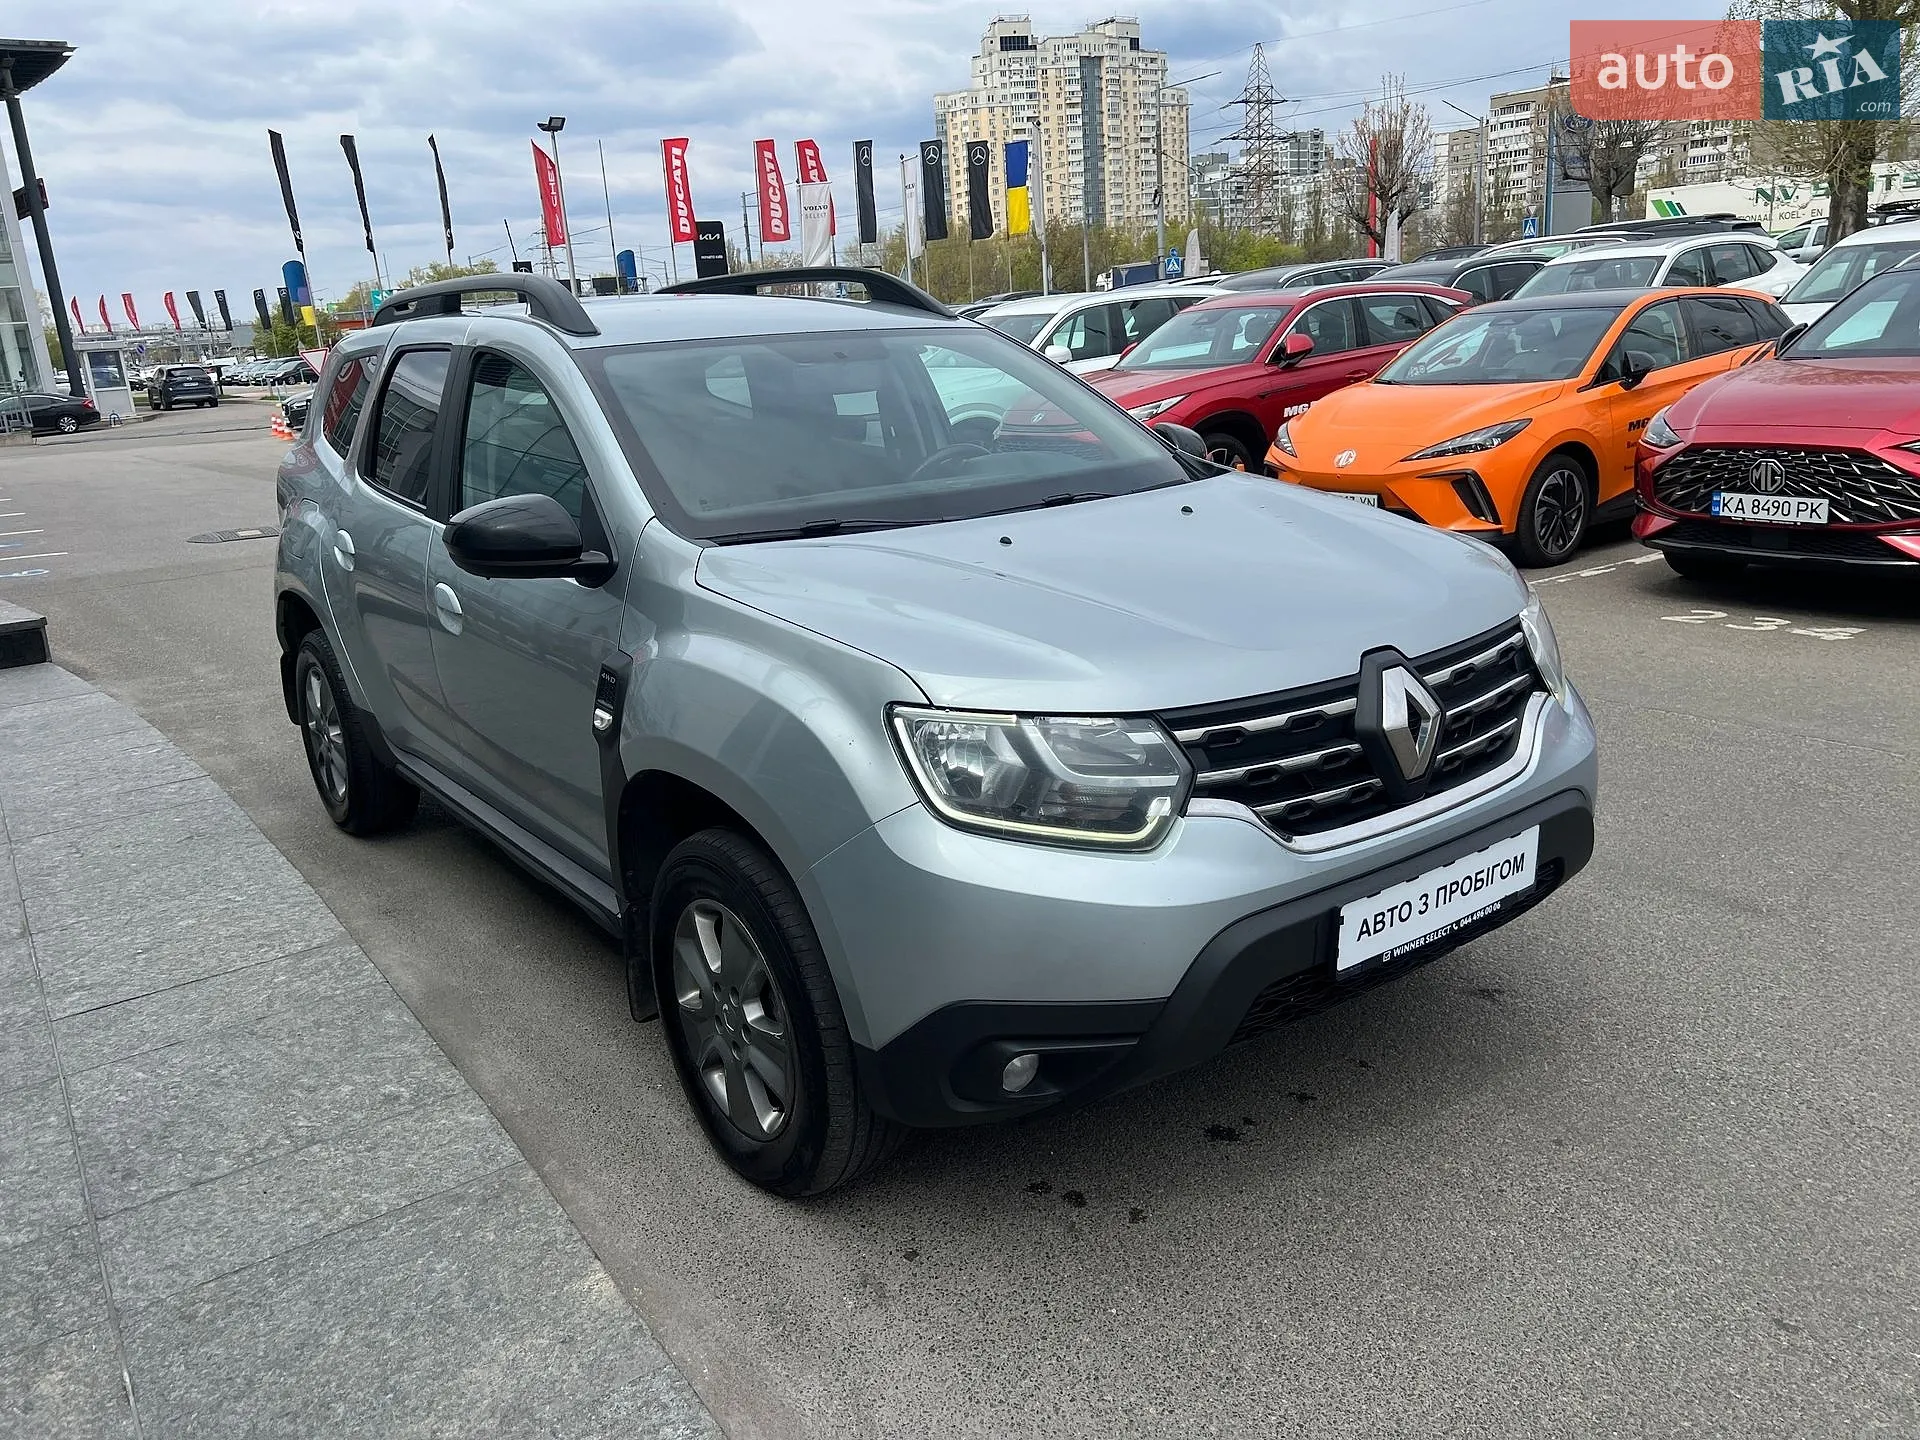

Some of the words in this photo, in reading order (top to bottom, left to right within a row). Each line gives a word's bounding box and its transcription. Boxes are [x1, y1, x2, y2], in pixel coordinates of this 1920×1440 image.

[671, 146, 691, 234] DUCATI
[763, 150, 785, 235] DUCATI
[1810, 208, 1824, 217] EN
[1752, 462, 1782, 491] MG
[1721, 496, 1746, 515] KA
[1751, 498, 1792, 517] 8490
[1796, 501, 1824, 520] PK
[1356, 899, 1414, 942] АВТО
[1434, 852, 1526, 909] ПРОБІГОМ
[1393, 937, 1425, 958] WINNER
[1425, 926, 1452, 944] SELECT
